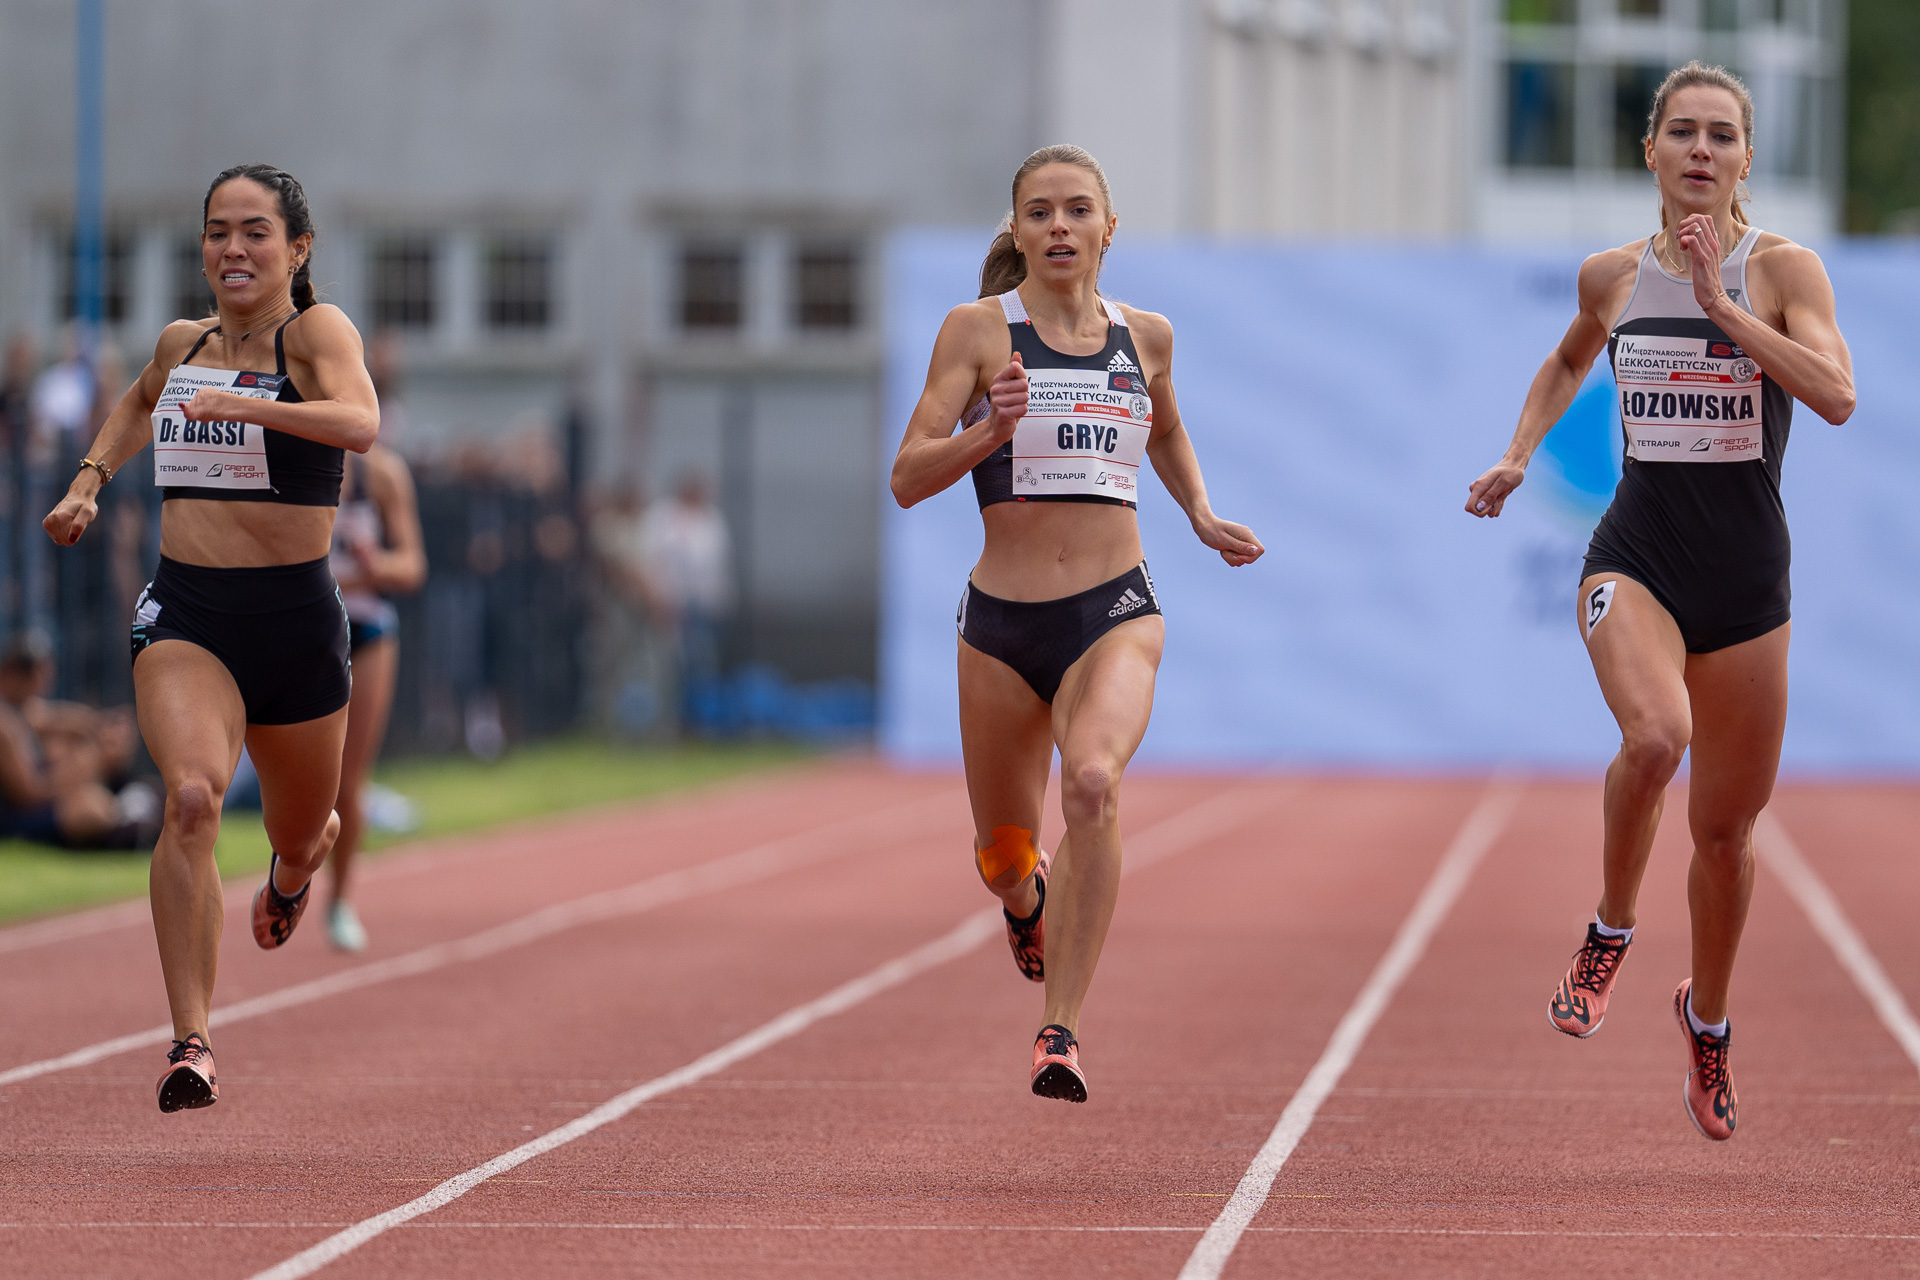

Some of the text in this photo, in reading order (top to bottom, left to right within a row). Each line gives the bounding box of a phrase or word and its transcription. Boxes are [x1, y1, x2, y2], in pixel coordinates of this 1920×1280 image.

[1620, 342, 1698, 357] IV MIĘDZYNARODOWY
[1107, 364, 1138, 374] adidas
[1619, 357, 1722, 372] LEKKOATLETYCZNY
[1027, 391, 1122, 404] KKOATLETYCZNY
[1622, 390, 1755, 420] ŁOZOWSKA
[183, 420, 245, 446] BASSI
[1057, 423, 1118, 454] GRYC
[1637, 440, 1680, 448] TETRAPUR
[1724, 442, 1759, 452] SPORT
[160, 465, 198, 473] TETRAPUR
[1114, 481, 1135, 491] SPORT
[1109, 597, 1147, 617] adidas
[1589, 586, 1606, 628] 5
